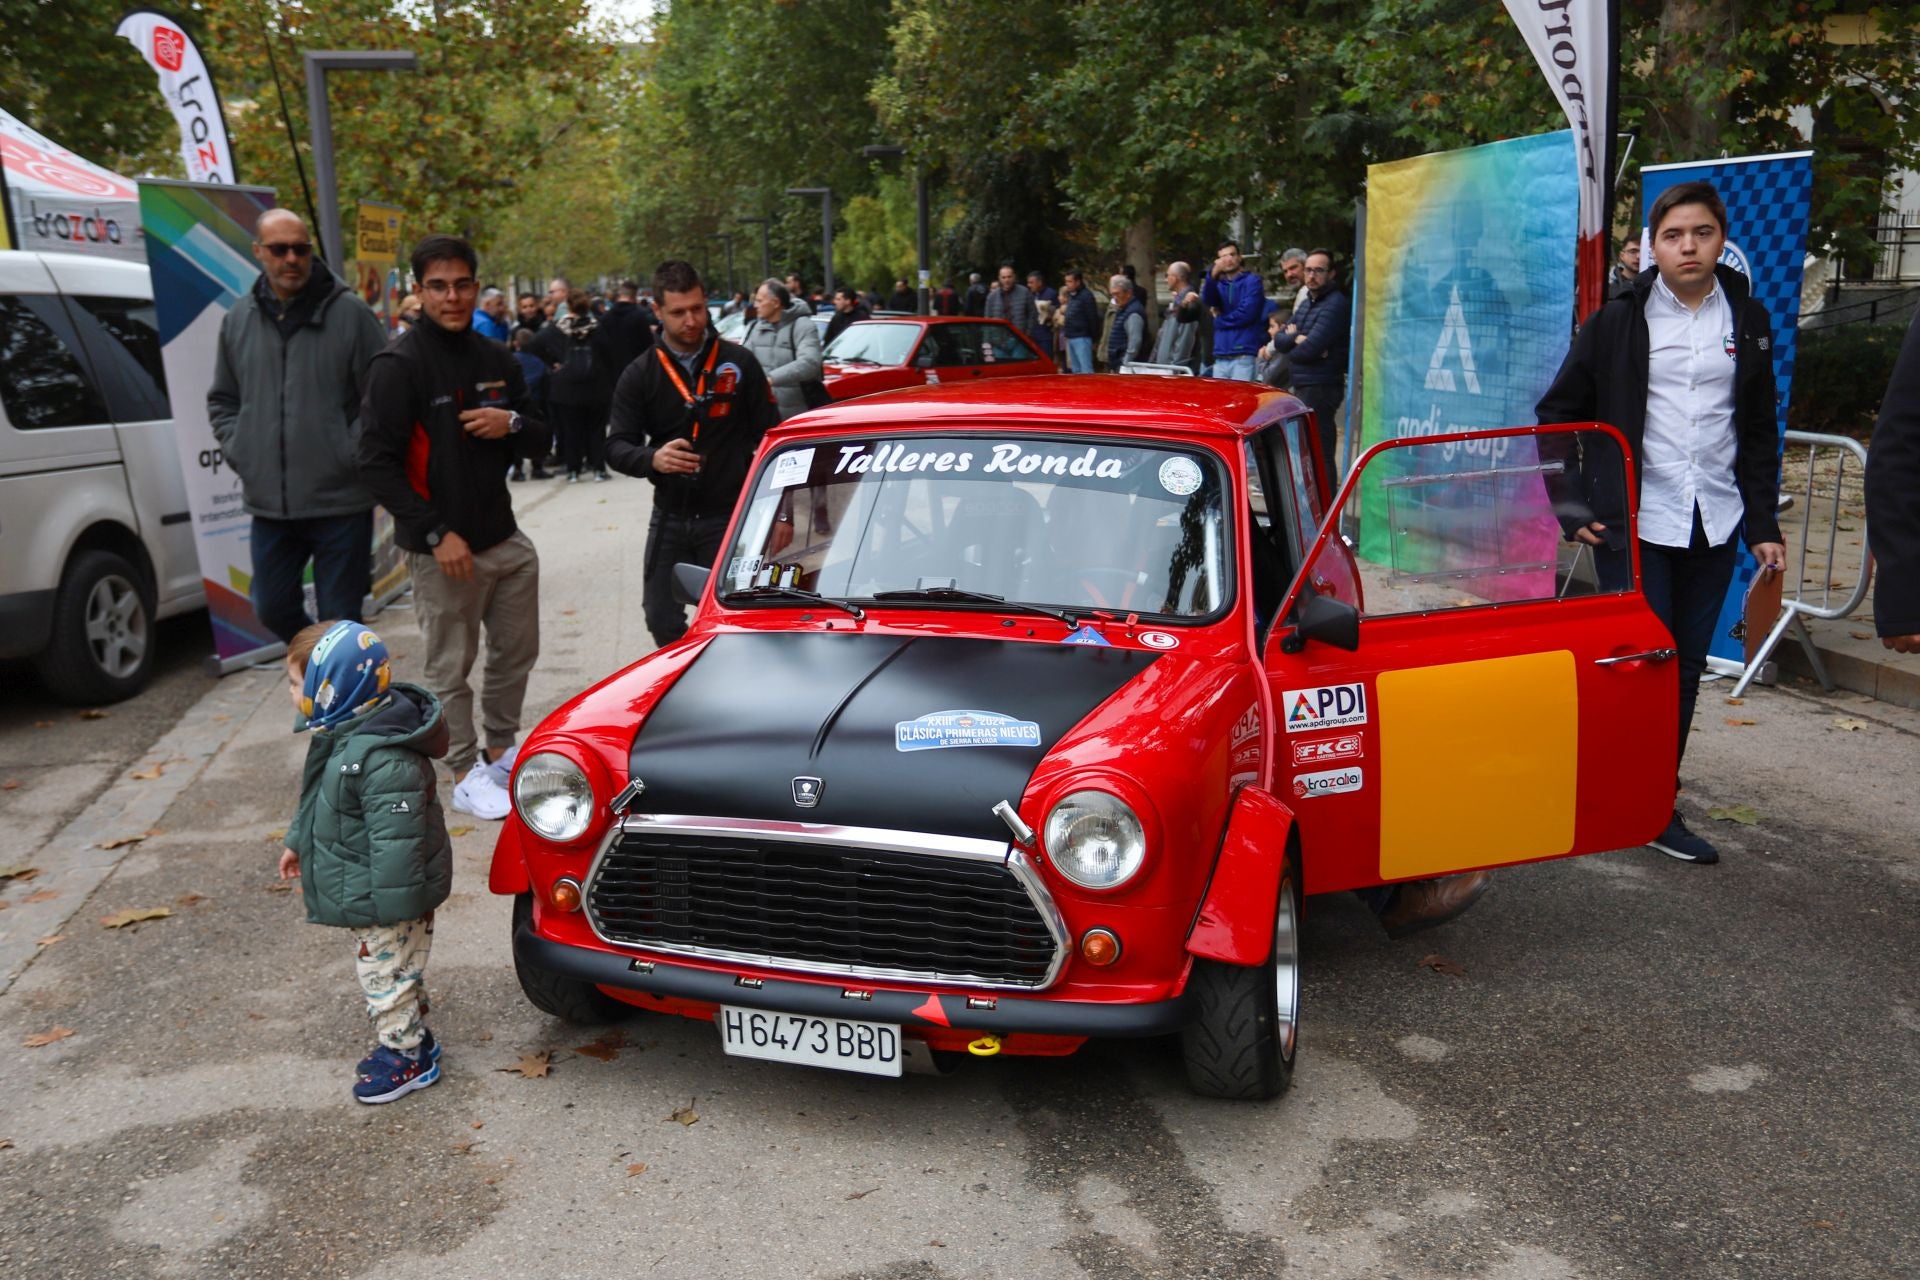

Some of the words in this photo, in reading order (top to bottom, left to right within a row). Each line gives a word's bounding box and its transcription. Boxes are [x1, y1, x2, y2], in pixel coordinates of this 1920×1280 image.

[834, 444, 974, 475] Talleres
[983, 443, 1123, 479] Ronda
[1152, 634, 1165, 645] E
[945, 728, 998, 739] PRIMERAS
[1000, 726, 1037, 740] NIEVES
[1302, 740, 1353, 758] FKG
